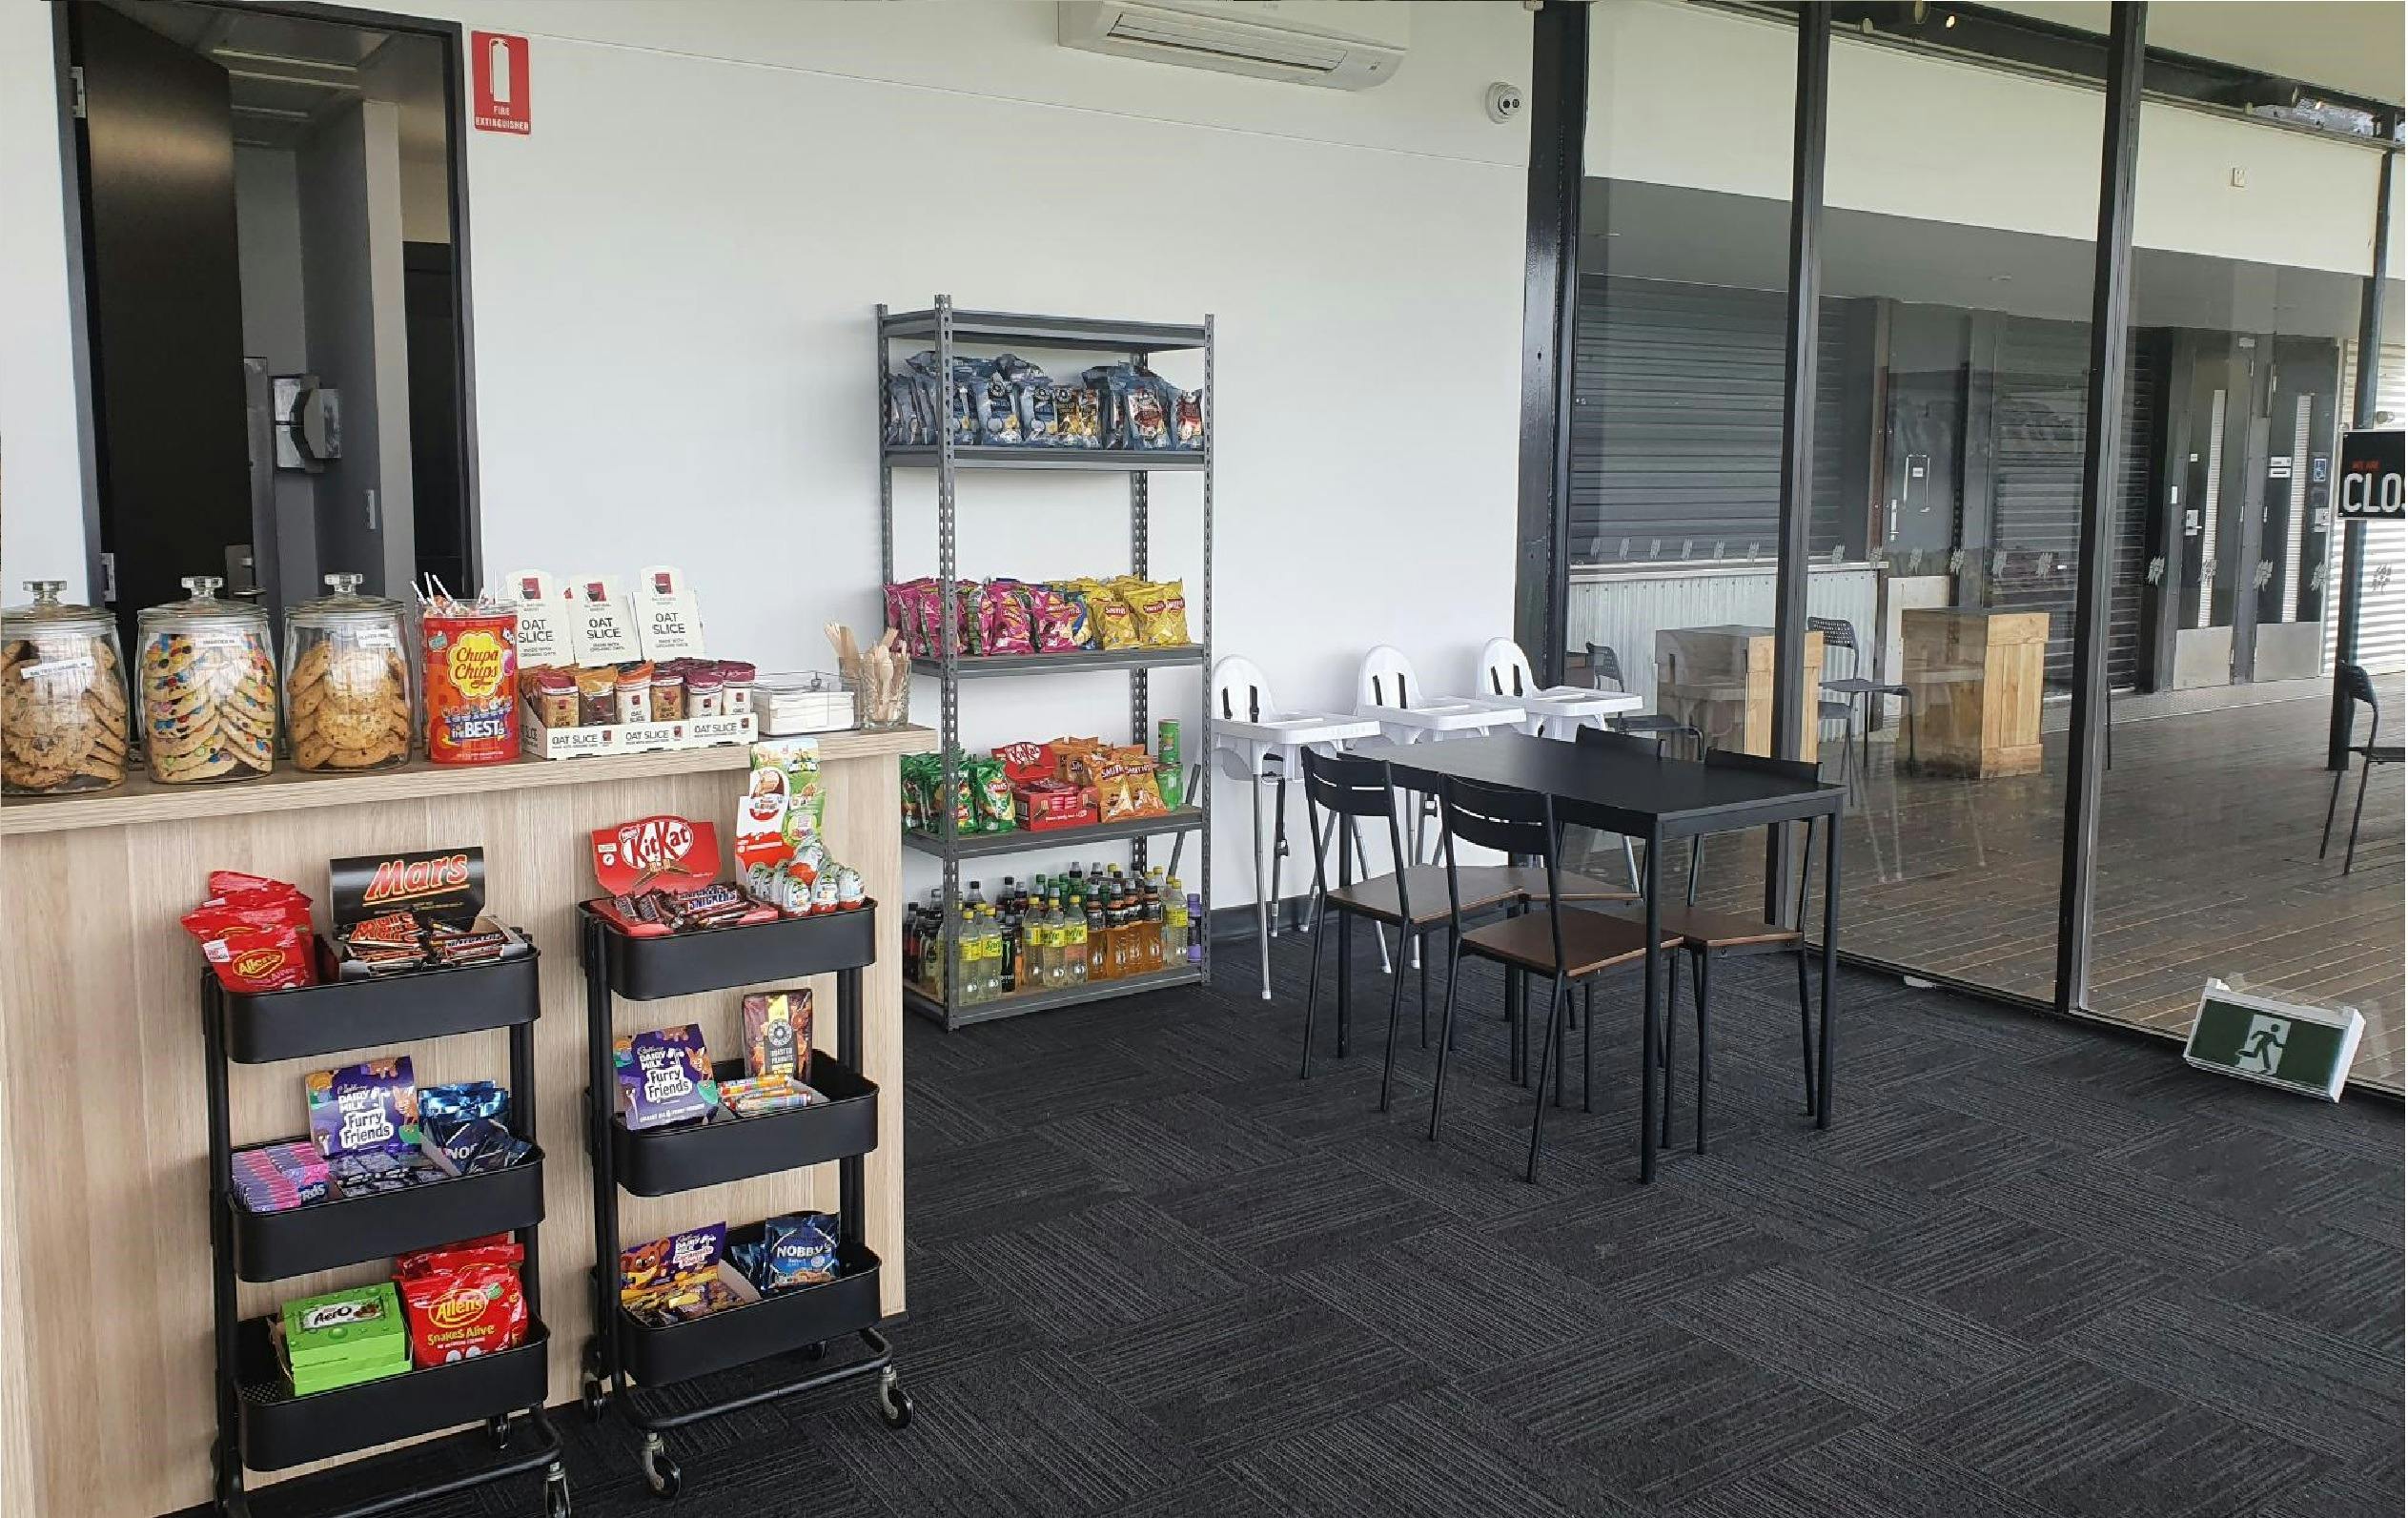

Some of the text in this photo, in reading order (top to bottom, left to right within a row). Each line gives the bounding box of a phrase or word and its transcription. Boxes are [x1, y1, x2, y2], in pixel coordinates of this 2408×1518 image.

[493, 105, 510, 116] FIRE
[475, 116, 529, 132] EXTINGUISHER
[2343, 472, 2405, 512] CLO
[521, 619, 547, 630] OAT
[588, 617, 613, 628] OAT
[655, 612, 678, 623] OAT
[586, 627, 622, 639] SLICE
[652, 623, 686, 635] SLICE
[518, 630, 554, 644] SLICE
[456, 646, 500, 666] Chupa
[454, 663, 499, 681] Chups
[464, 720, 500, 738] BEST
[625, 729, 669, 740] OAT SLICE
[694, 722, 738, 733] OAT SLICE
[551, 733, 598, 745] OAT SLICE
[629, 821, 690, 868] KitKat
[363, 854, 468, 902] Mars
[650, 1069, 681, 1083] Furry
[647, 1079, 689, 1098] Friends
[348, 1112, 383, 1130] Furry
[343, 1122, 390, 1145] Friends
[427, 1328, 465, 1345] Snakes
[466, 1324, 495, 1339] Alive
